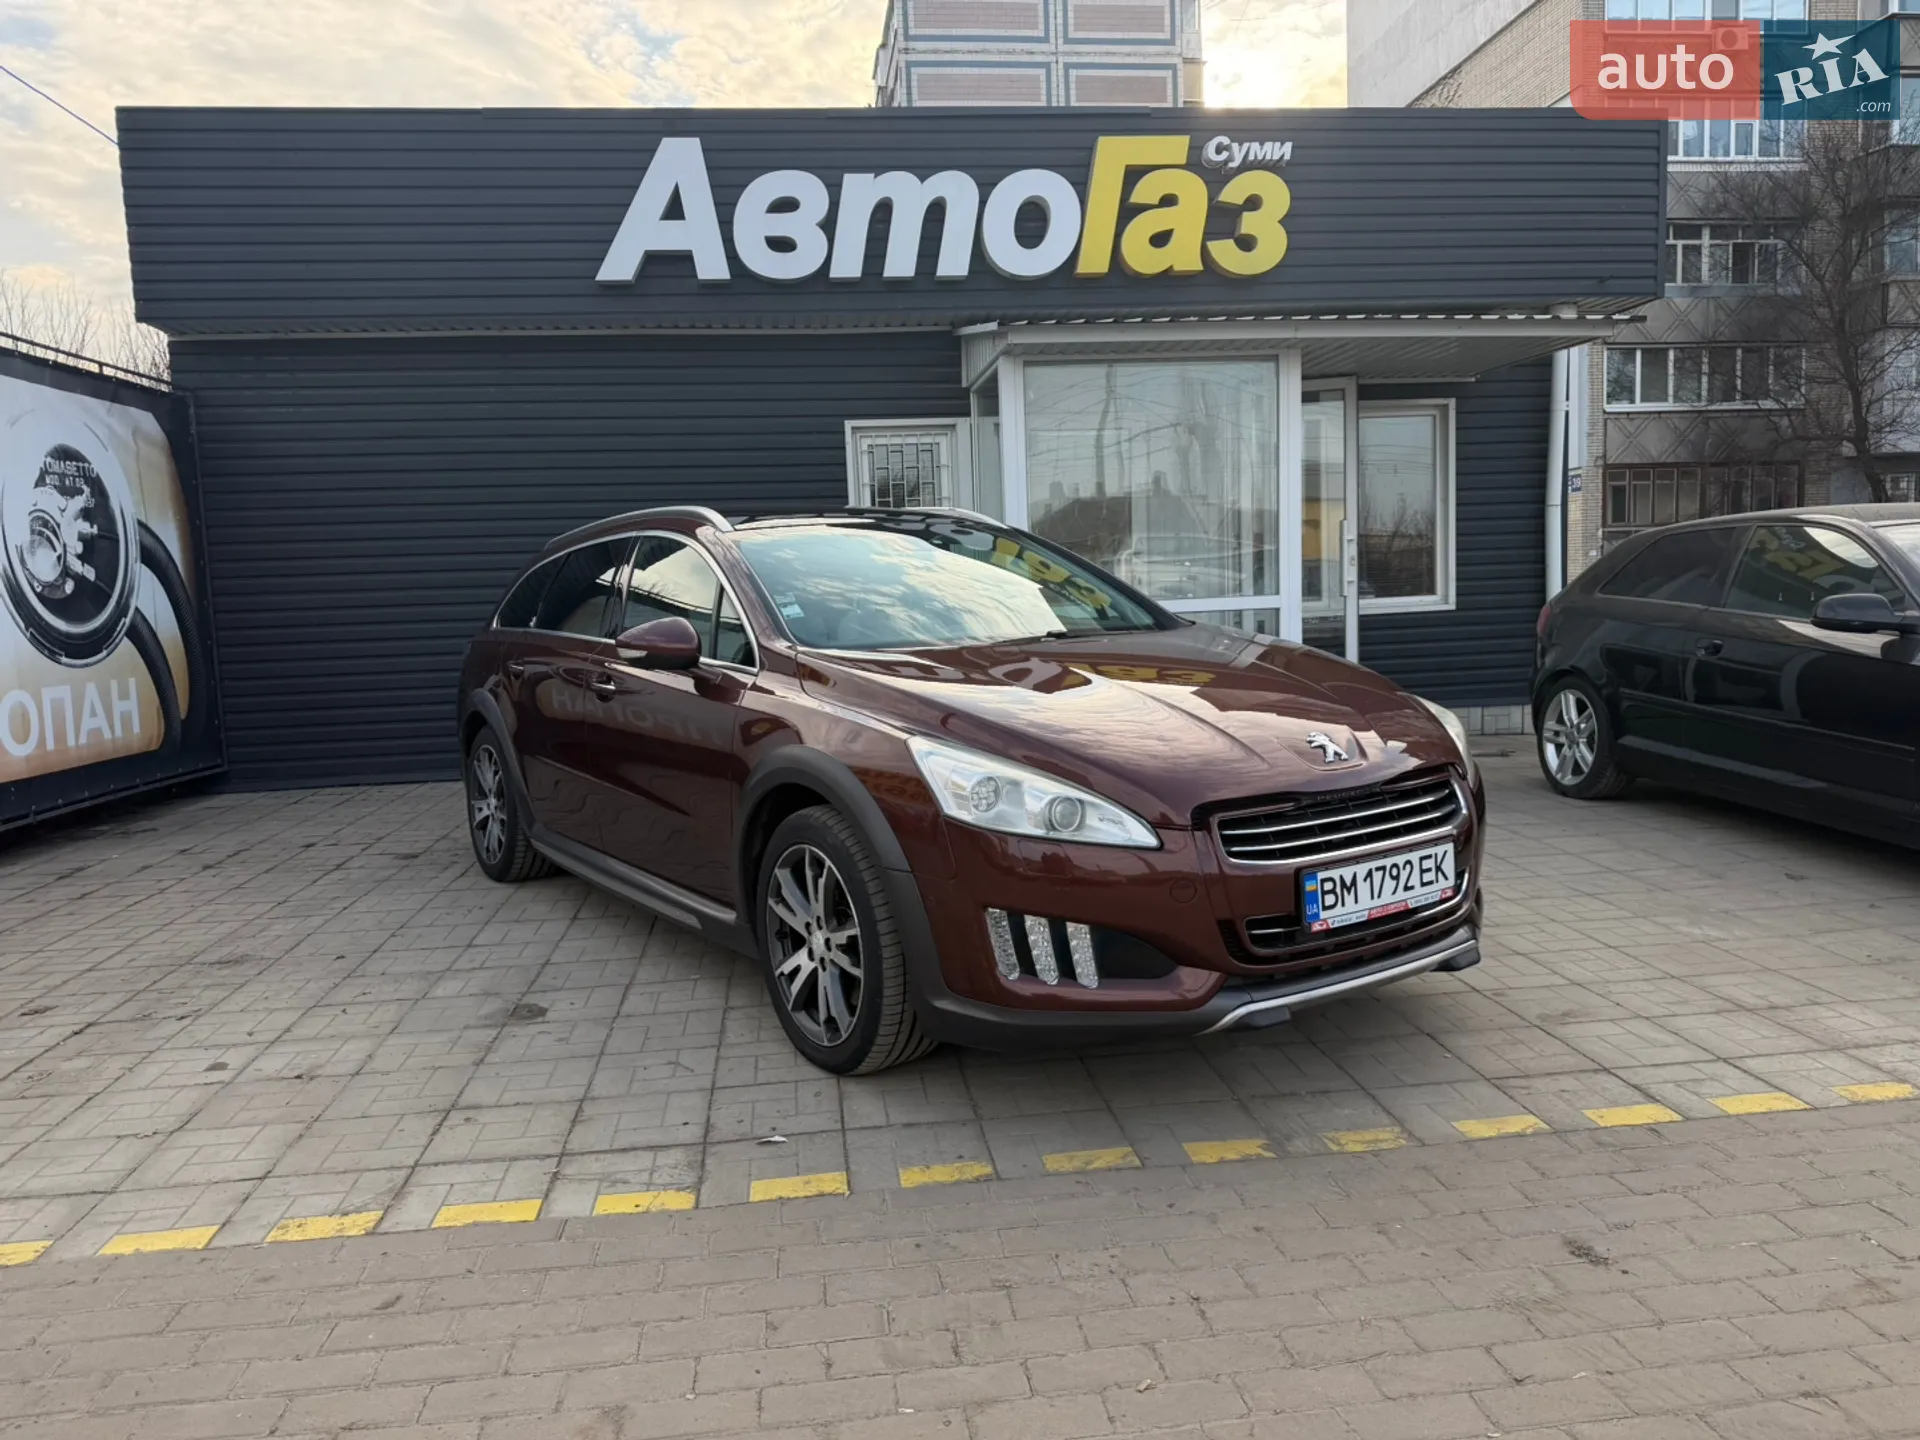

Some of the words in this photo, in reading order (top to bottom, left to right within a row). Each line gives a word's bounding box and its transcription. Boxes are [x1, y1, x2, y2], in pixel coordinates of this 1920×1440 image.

[1201, 134, 1293, 170] Суми
[0, 677, 141, 757] ОПАН
[1306, 903, 1318, 915] UA
